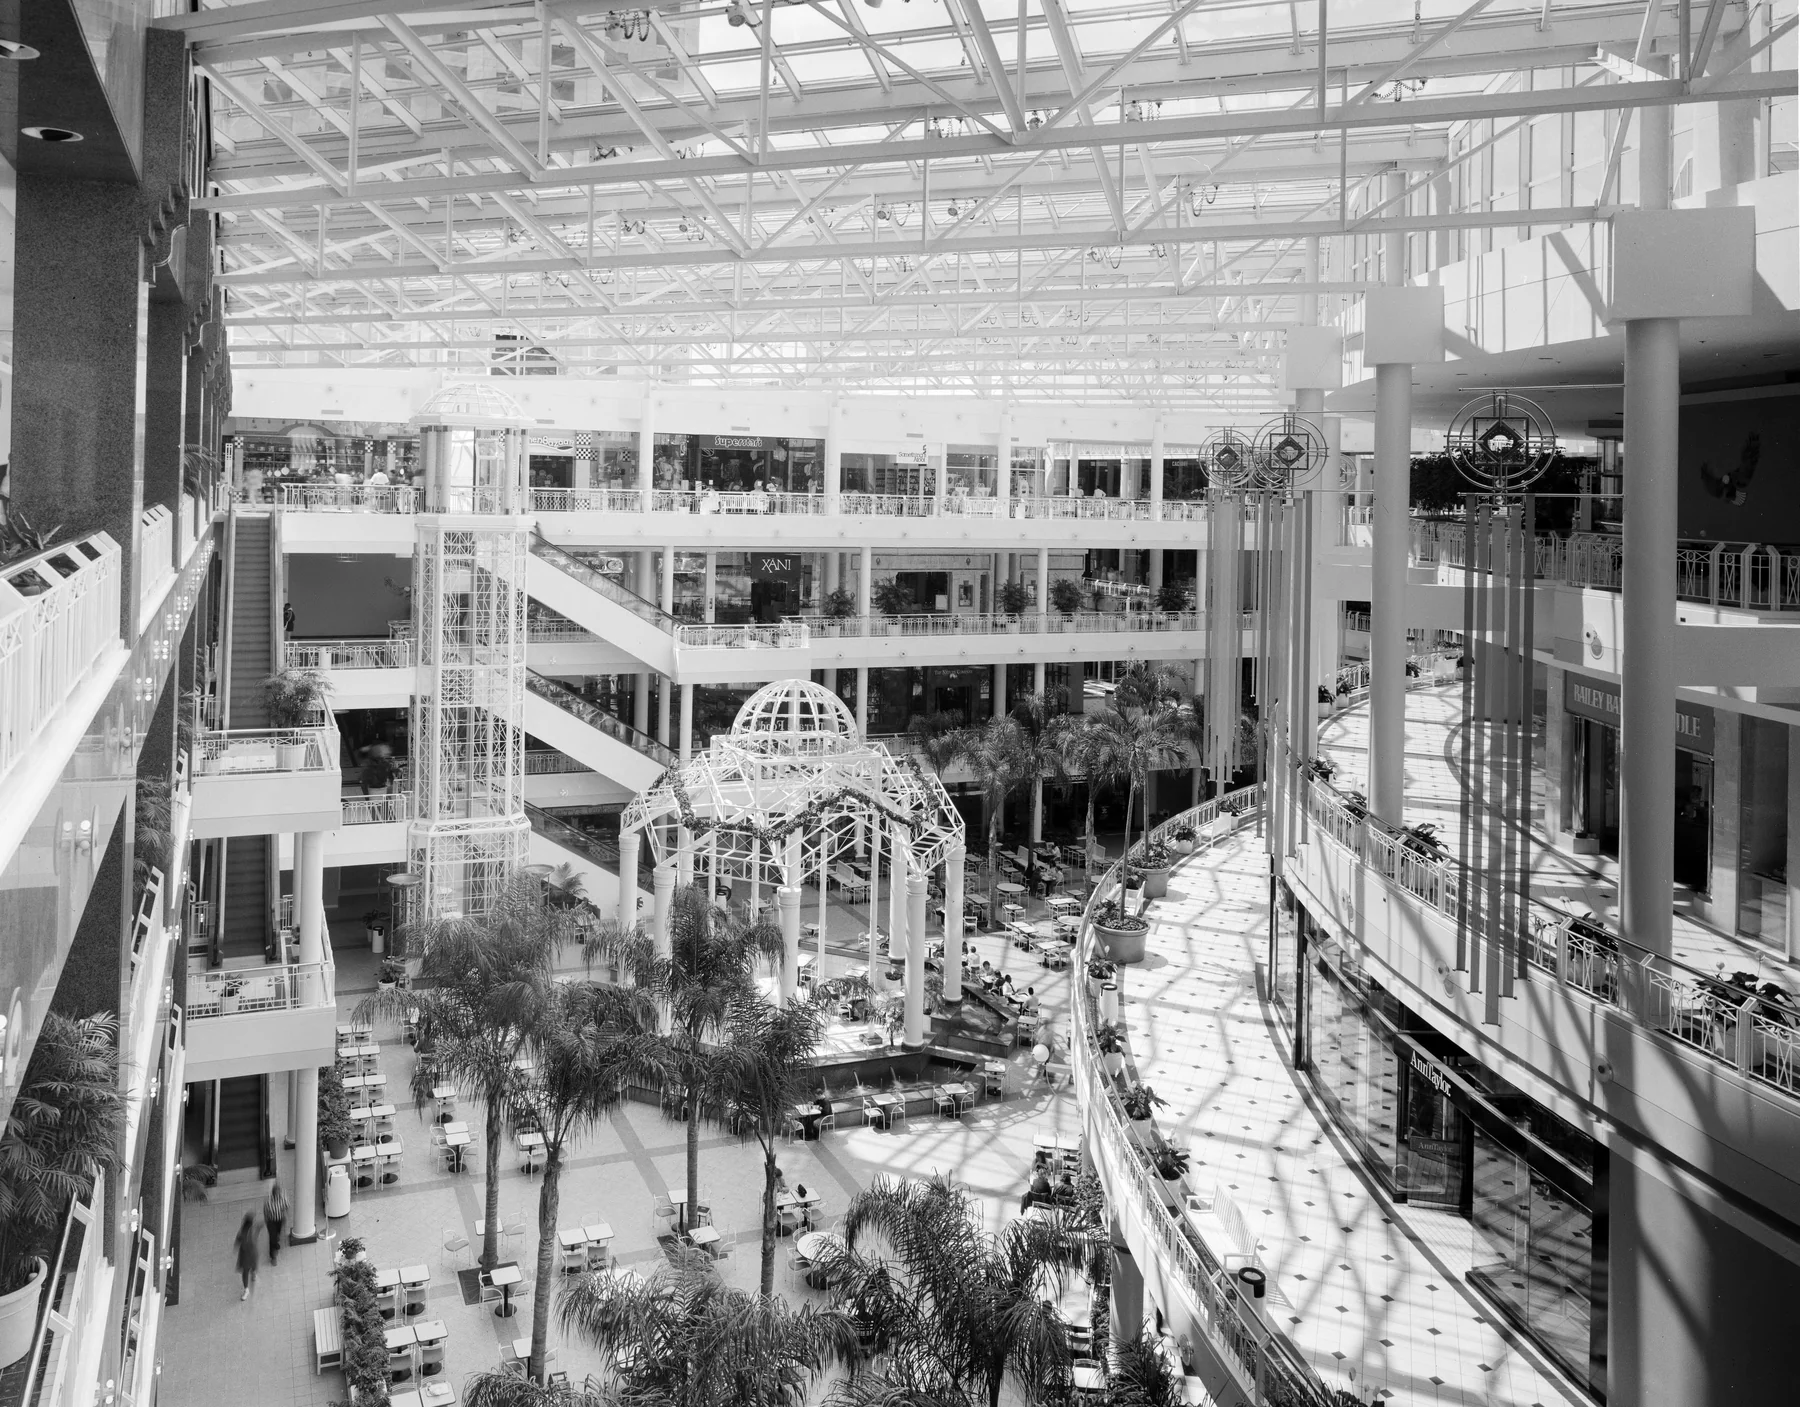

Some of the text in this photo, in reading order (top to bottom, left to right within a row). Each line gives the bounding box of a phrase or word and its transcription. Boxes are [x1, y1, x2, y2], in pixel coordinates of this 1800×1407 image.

[761, 558, 791, 574] XANI
[1574, 683, 1701, 738] BAILEY BA DLE
